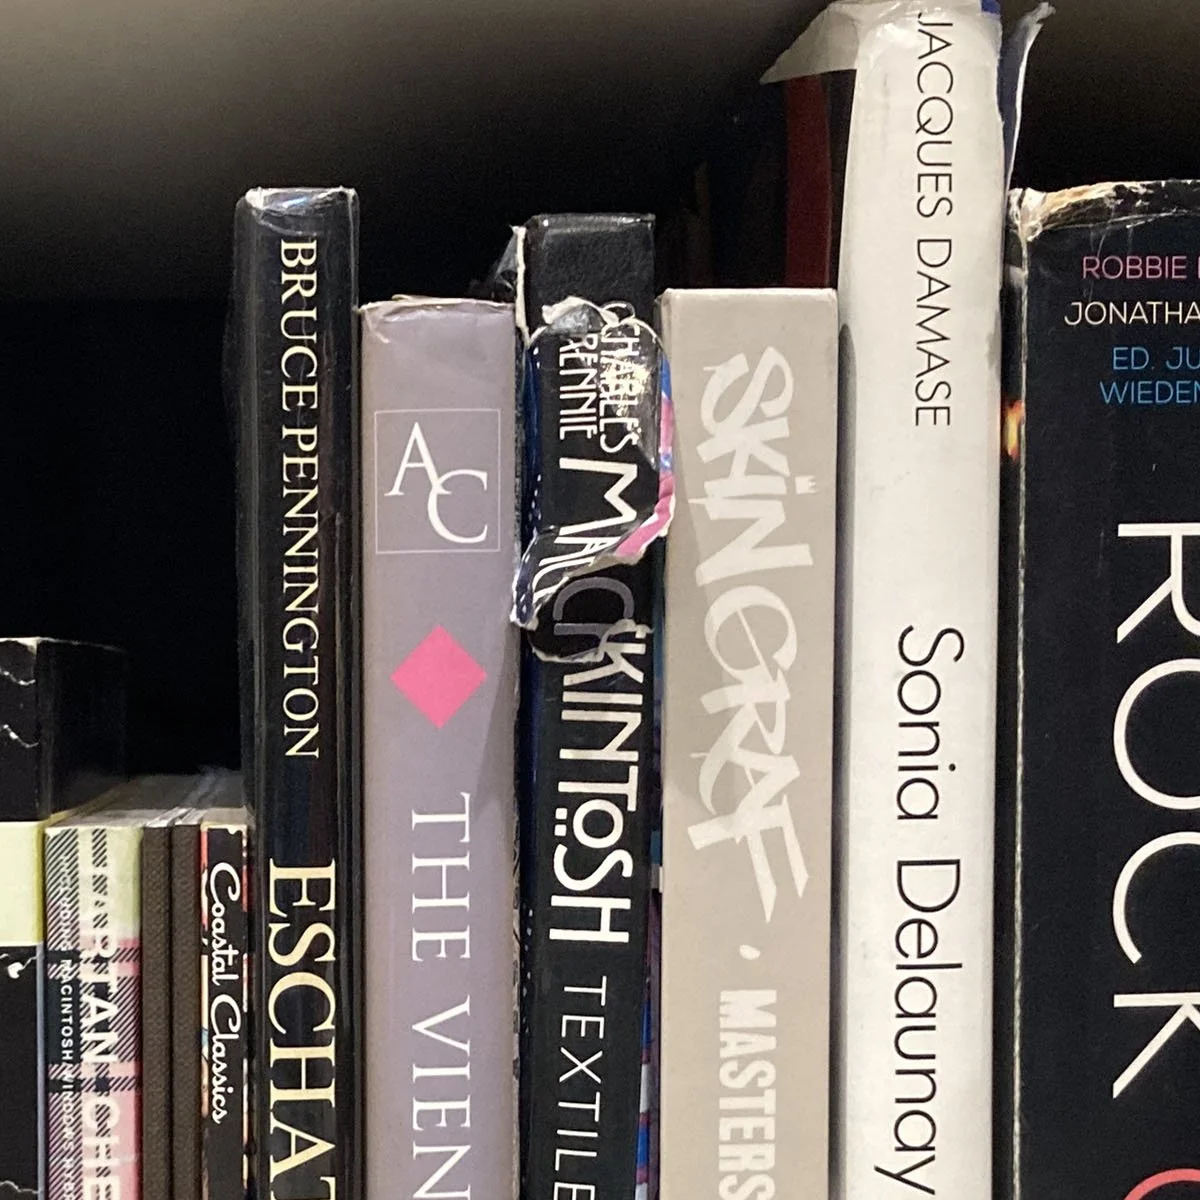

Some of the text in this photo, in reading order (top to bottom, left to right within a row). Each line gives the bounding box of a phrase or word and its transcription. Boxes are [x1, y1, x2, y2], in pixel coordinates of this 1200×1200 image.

[914, 11, 955, 427] JACQUES DAMASE
[1082, 254, 1188, 280] ROBBIE
[559, 334, 599, 441] RENNIE
[1111, 346, 1157, 371] ED.
[279, 239, 320, 758] BRUCE PENNINGTON
[688, 584, 810, 923] GRAF
[896, 624, 965, 820] Sonia
[1111, 522, 1200, 1100] ROCK
[209, 861, 242, 1125] Coastal Classics
[411, 791, 472, 963] THE
[873, 858, 963, 1196] Delaunay
